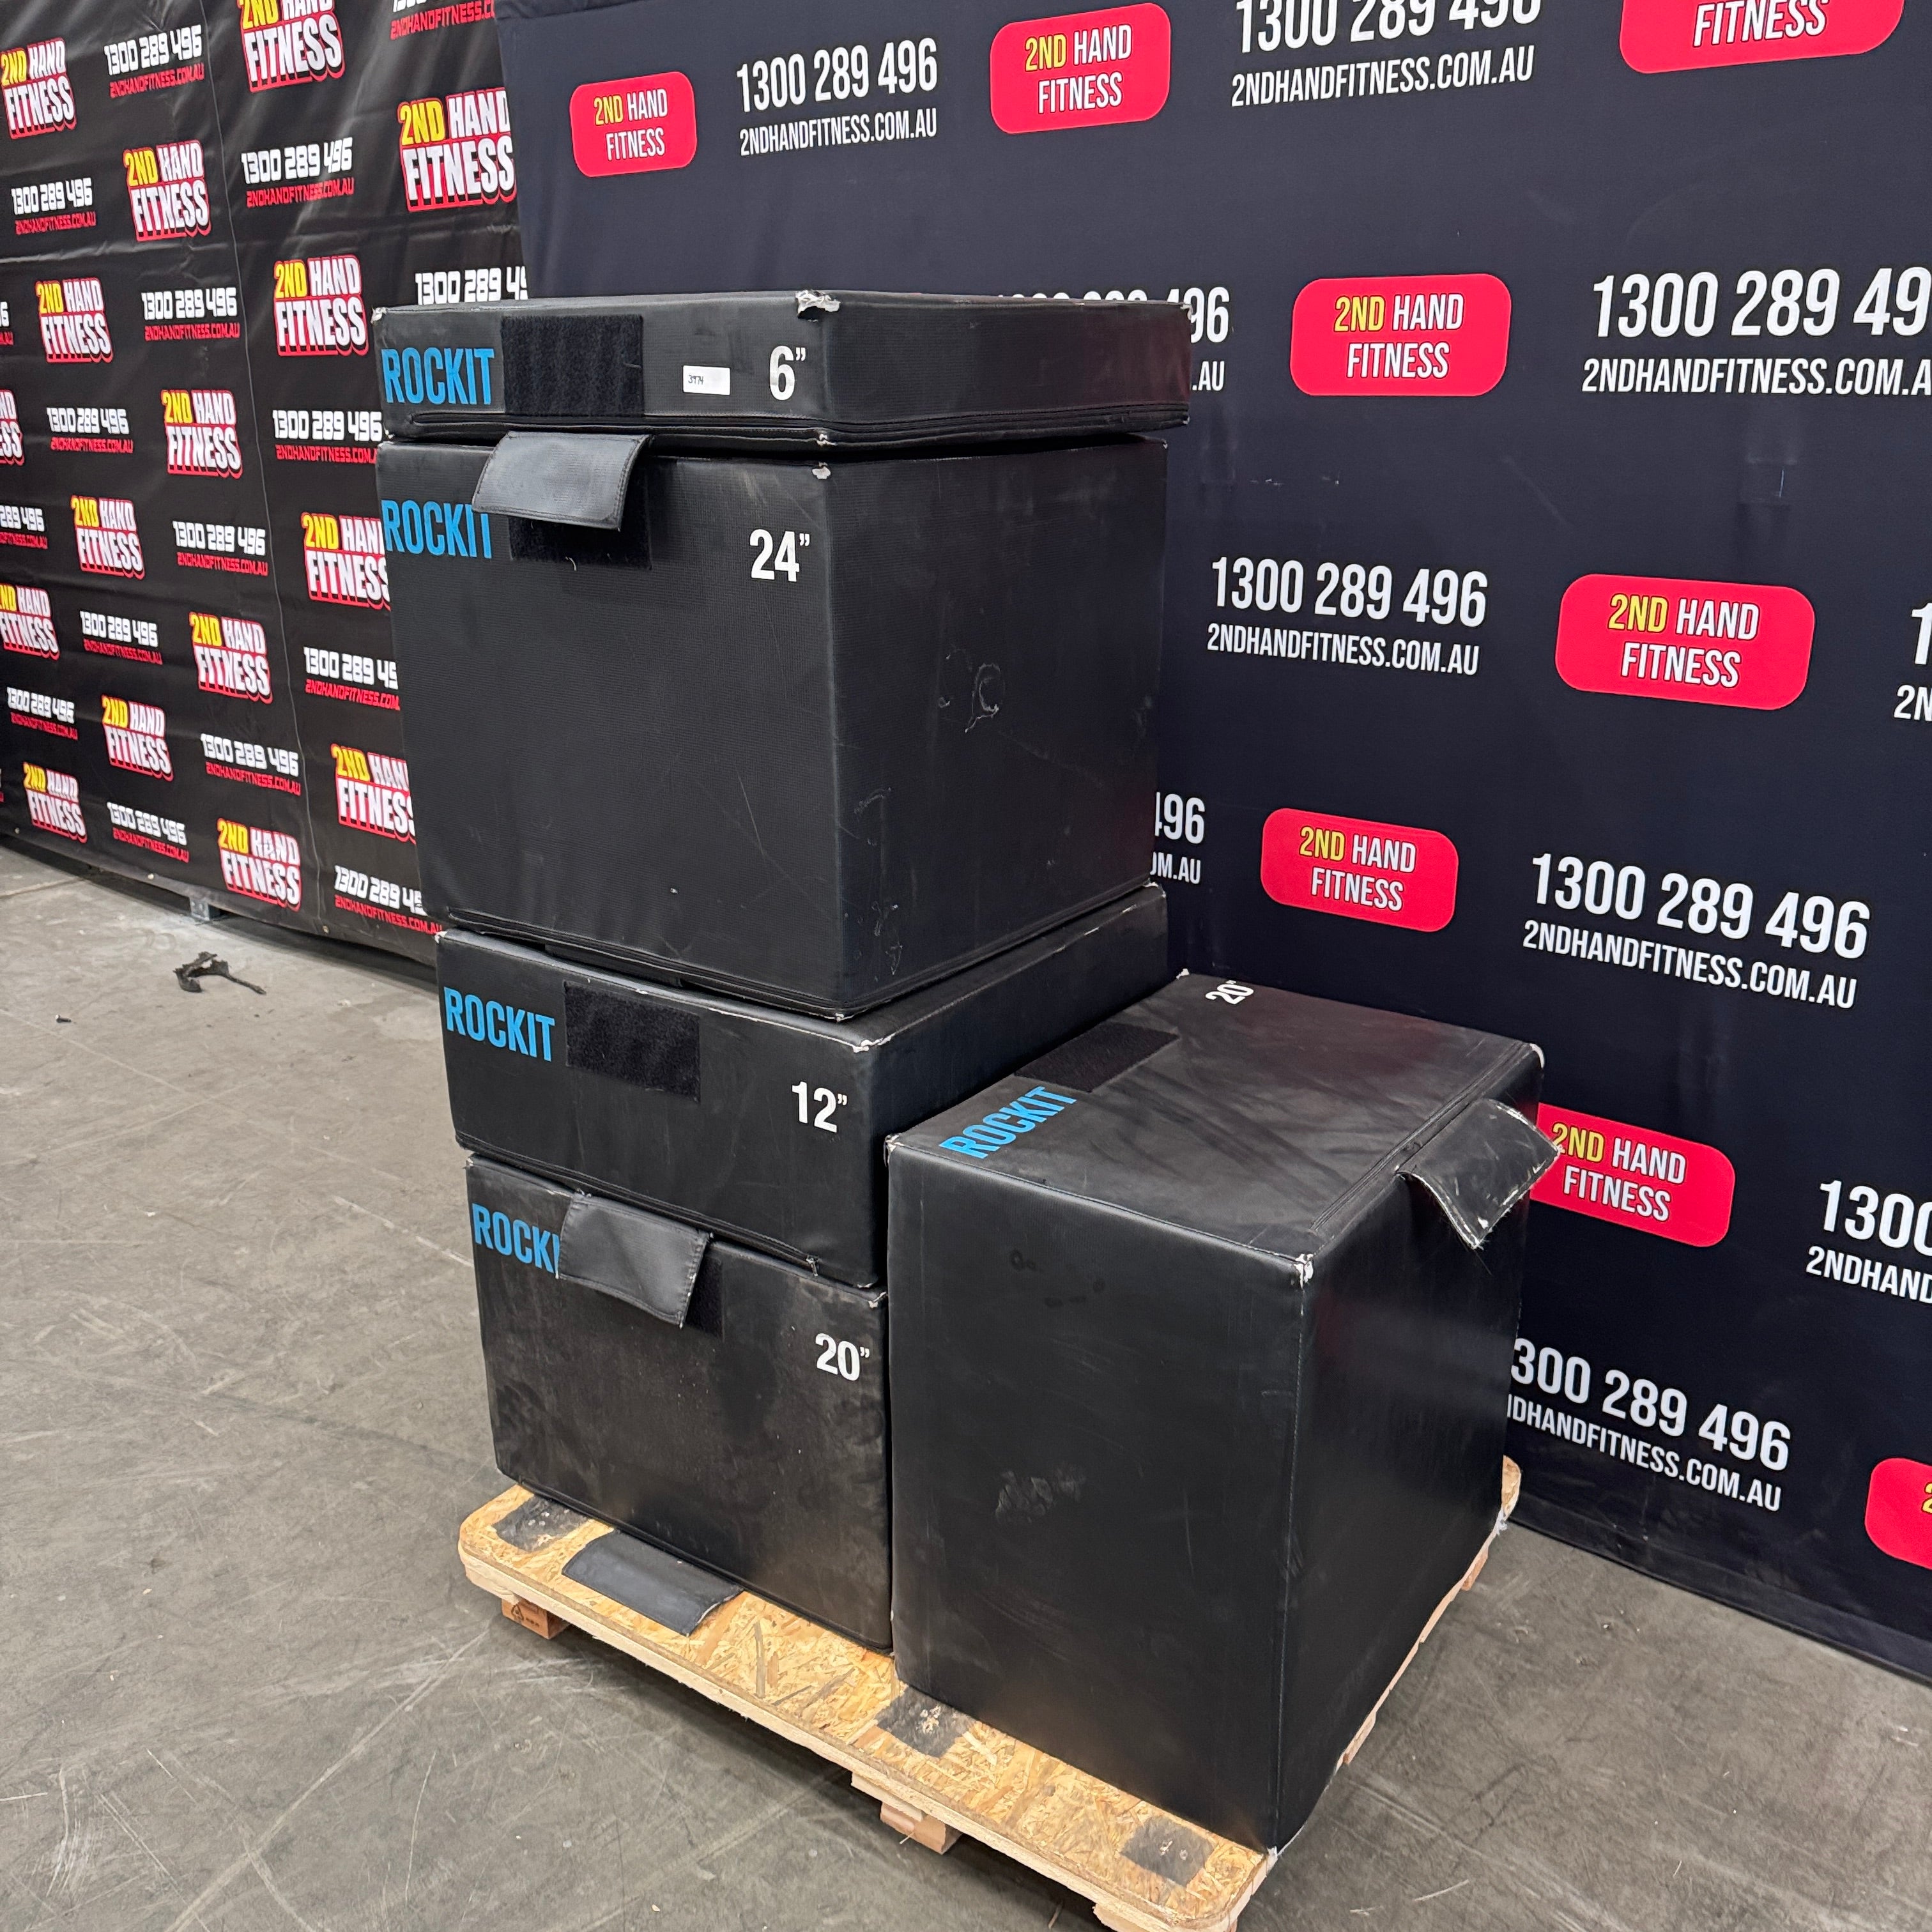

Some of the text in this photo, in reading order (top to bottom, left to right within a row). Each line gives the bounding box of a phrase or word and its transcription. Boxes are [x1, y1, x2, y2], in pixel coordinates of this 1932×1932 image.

[240, 0, 279, 29] 2ND
[1236, 0, 1337, 53] 1300
[1350, 0, 1435, 42] 289
[1693, 0, 1827, 47] FITNESS
[1, 40, 65, 86] 2ND HAND
[104, 24, 202, 75] 1300 289 496
[244, 14, 342, 82] FITNESS
[1025, 25, 1131, 71] 2ND HAND
[737, 37, 937, 113] 1300 289 496
[1038, 72, 1123, 114] FITNESS
[1232, 45, 1535, 107] 2NDHANDFITNESS.COM.AU
[4, 76, 75, 130] FITNESS
[399, 90, 511, 146] 2ND HAND
[594, 89, 668, 126] 2ND HAND
[606, 128, 665, 161] FITNESS
[740, 108, 937, 157] 2NDHANDFITNESS.COM.AU
[125, 143, 203, 186] 2ND HAND
[241, 137, 352, 184] 1300 289 496
[402, 137, 514, 201] FITNESS
[11, 178, 92, 215] 1300 289 496
[130, 181, 209, 232] FITNESS
[247, 178, 354, 208] 2NDHANDFITNESS.COM.AU
[36, 280, 103, 313] 2ND HAND
[275, 258, 361, 298] 2ND HAND
[415, 272, 460, 305] 1300
[464, 268, 501, 302] 289
[141, 288, 237, 320] 1300 289 496
[276, 297, 367, 346] FITNESS
[1334, 294, 1464, 333] 2ND HAND
[1593, 272, 1719, 338] 1300
[1731, 268, 1840, 337] 289
[41, 314, 111, 355] FITNESS
[381, 348, 494, 405] ROCKIT
[1346, 342, 1450, 379] FITNESS
[47, 408, 129, 434] 1300 289 496
[161, 390, 235, 424] 2ND HAND
[273, 410, 382, 441] 1300 289 496
[167, 426, 241, 470] FITNESS
[275, 445, 377, 464] 2NDHANDFITNESS.COM.
[20, 507, 45, 532] 496
[71, 496, 136, 531] 2ND HAND
[302, 513, 385, 554] 2ND HAN
[381, 500, 492, 559] ROCKIT
[77, 528, 144, 571] FITNESS
[172, 521, 265, 556] 1300 289 496
[16, 586, 50, 617] HAND
[1212, 557, 1489, 627] 1300 289 496
[0, 611, 59, 653] FITNESS
[80, 611, 158, 648] 1300 289 496
[190, 614, 266, 654] 2ND HAND
[1608, 594, 1760, 641] 2ND HAND
[194, 645, 271, 696] FITNESS
[303, 647, 374, 686] 1300 289
[1207, 624, 1480, 675] 2NDHANDFITNESS.COM.AU
[1621, 641, 1741, 687] FITNESS
[6, 686, 75, 724] 1300 289 496
[102, 694, 128, 729] 2ND
[128, 701, 165, 738] HAND
[103, 724, 171, 775] FITNESS
[200, 733, 299, 777] 1300 289 496
[331, 744, 409, 791] 2ND HAN
[23, 762, 47, 792] 2ND
[46, 768, 79, 803] HAND
[206, 762, 301, 796] 2NDHANDFITNESS.COM.AU
[26, 788, 86, 837] FITNESS
[107, 801, 187, 846] 1300 289 496
[218, 819, 300, 866] 2ND HAND
[1299, 825, 1416, 873] 2ND HAND
[221, 850, 300, 905] FITNESS
[334, 865, 401, 910] 1300 289
[1311, 866, 1404, 912] FITNESS
[1533, 854, 1871, 959] 1300 289 496
[1522, 920, 1857, 1009] 2NDHANDFITNESS.COM.AU
[444, 986, 555, 1062] ROCKIT
[939, 1086, 1077, 1160] ROCKIT
[1552, 1123, 1686, 1185] 2ND HAND
[1563, 1165, 1671, 1222] FITNESS
[471, 1202, 559, 1274] ROCKI
[1510, 1338, 1790, 1471] 300 289 496
[1507, 1394, 1781, 1512] DHANDFITNESS.COM.AU
